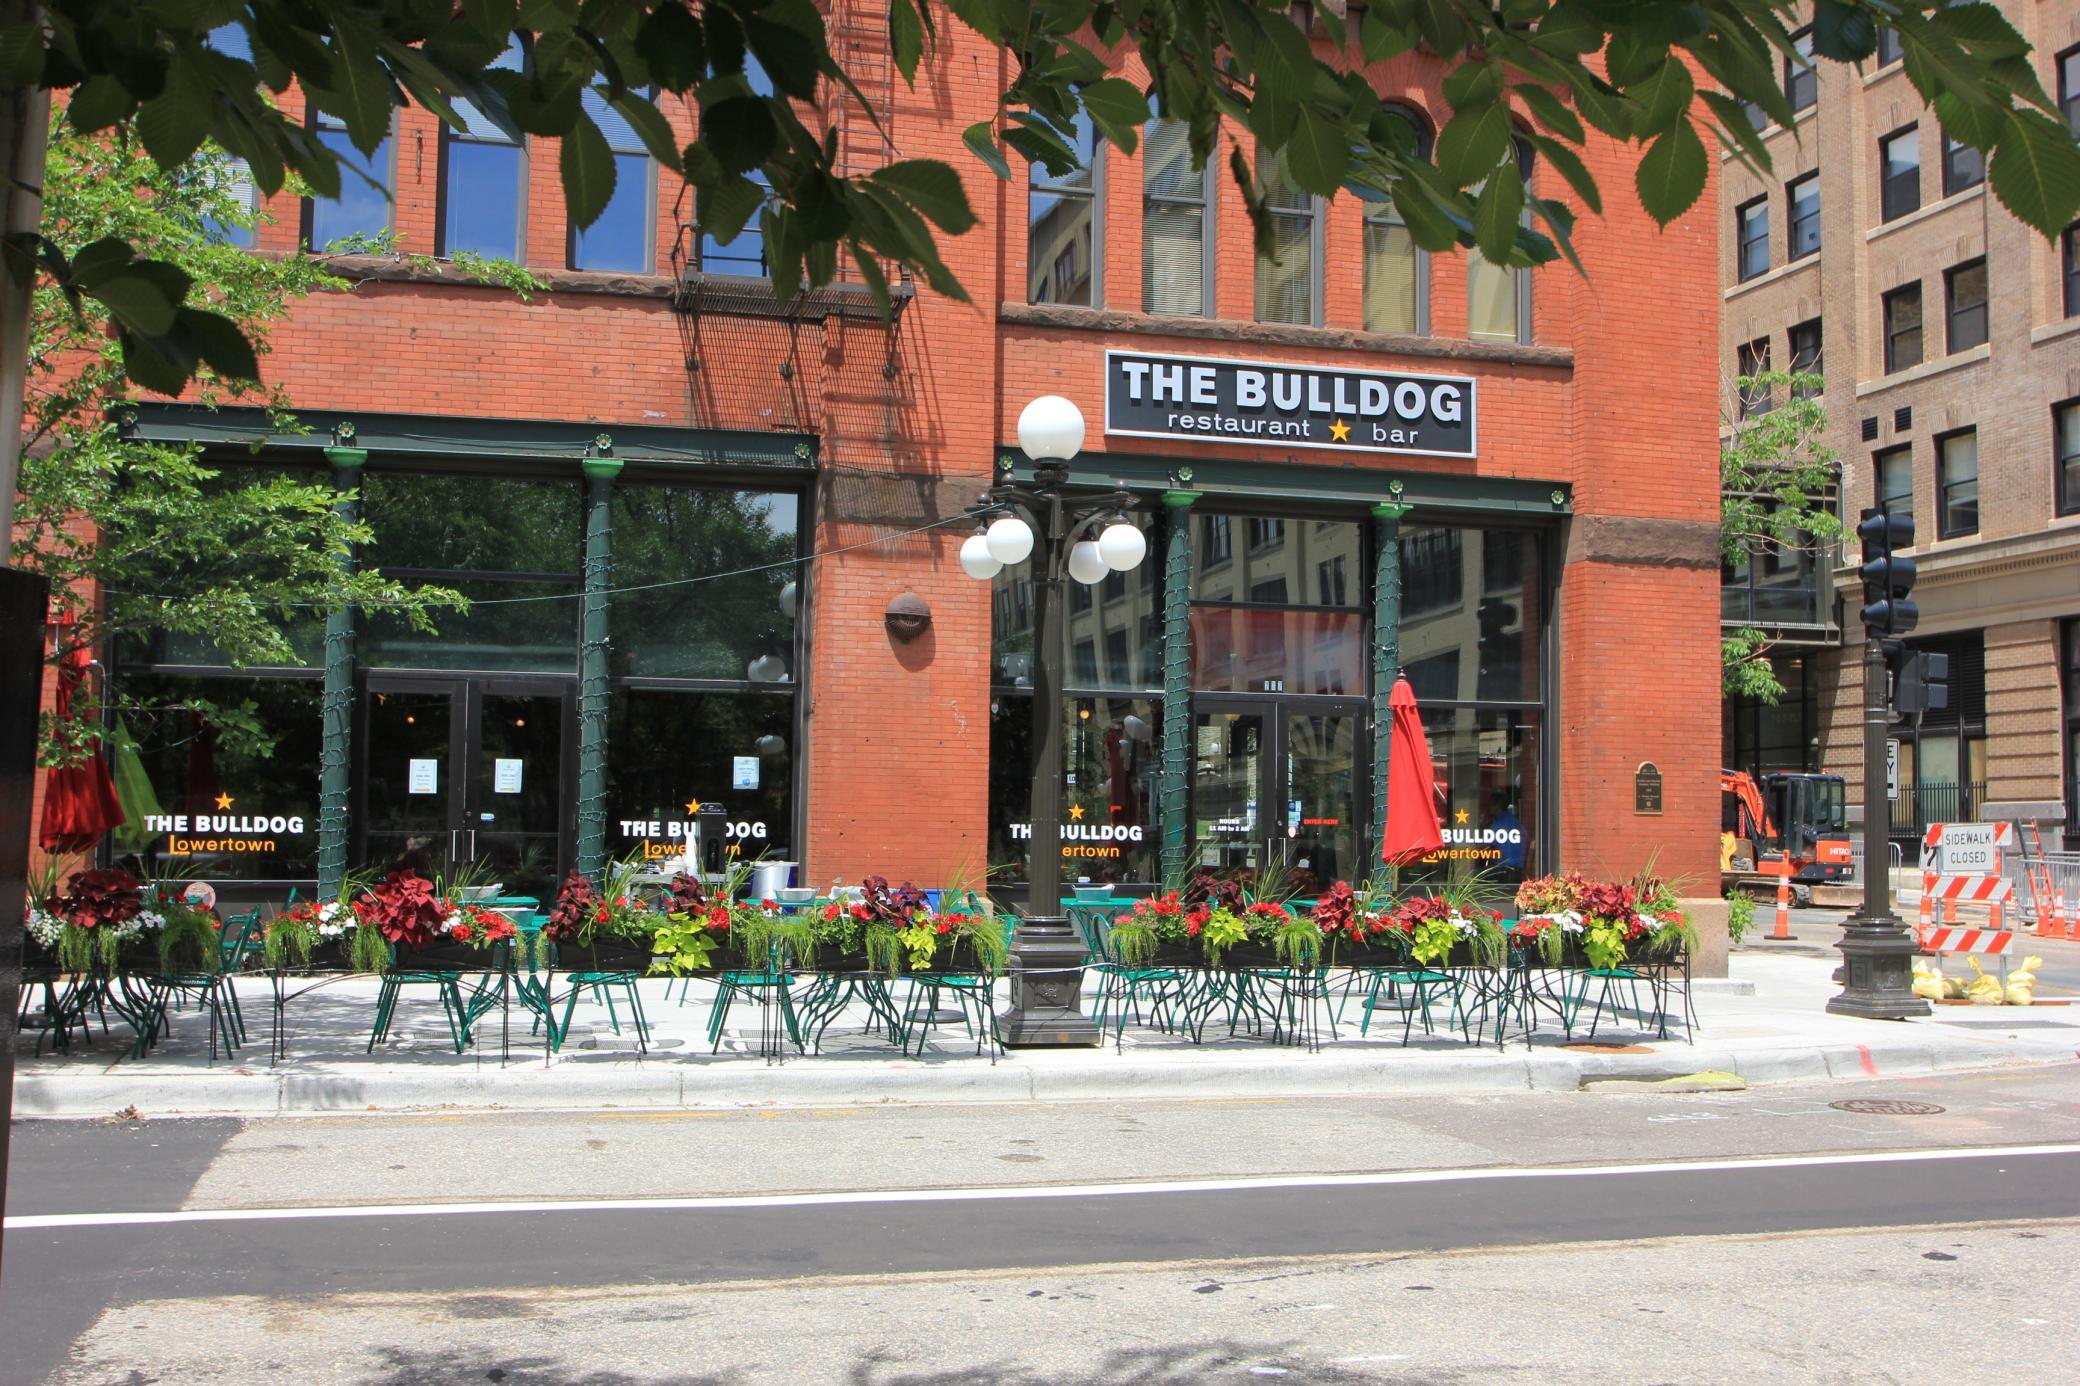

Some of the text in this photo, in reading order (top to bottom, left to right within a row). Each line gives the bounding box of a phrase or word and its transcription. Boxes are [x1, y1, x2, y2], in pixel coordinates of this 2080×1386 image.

[1122, 361, 1462, 422] THE BULLDOG
[1168, 412, 1419, 444] restaurant bar
[144, 815, 304, 834] THE BULLDOG
[620, 820, 767, 838] THE BUDOG
[1009, 823, 1032, 839] TH
[170, 835, 275, 855] Lowertown
[1945, 832, 1991, 846] SIDEWALK
[1062, 845, 1120, 857] ertown
[1950, 851, 1987, 864] CLOSED
